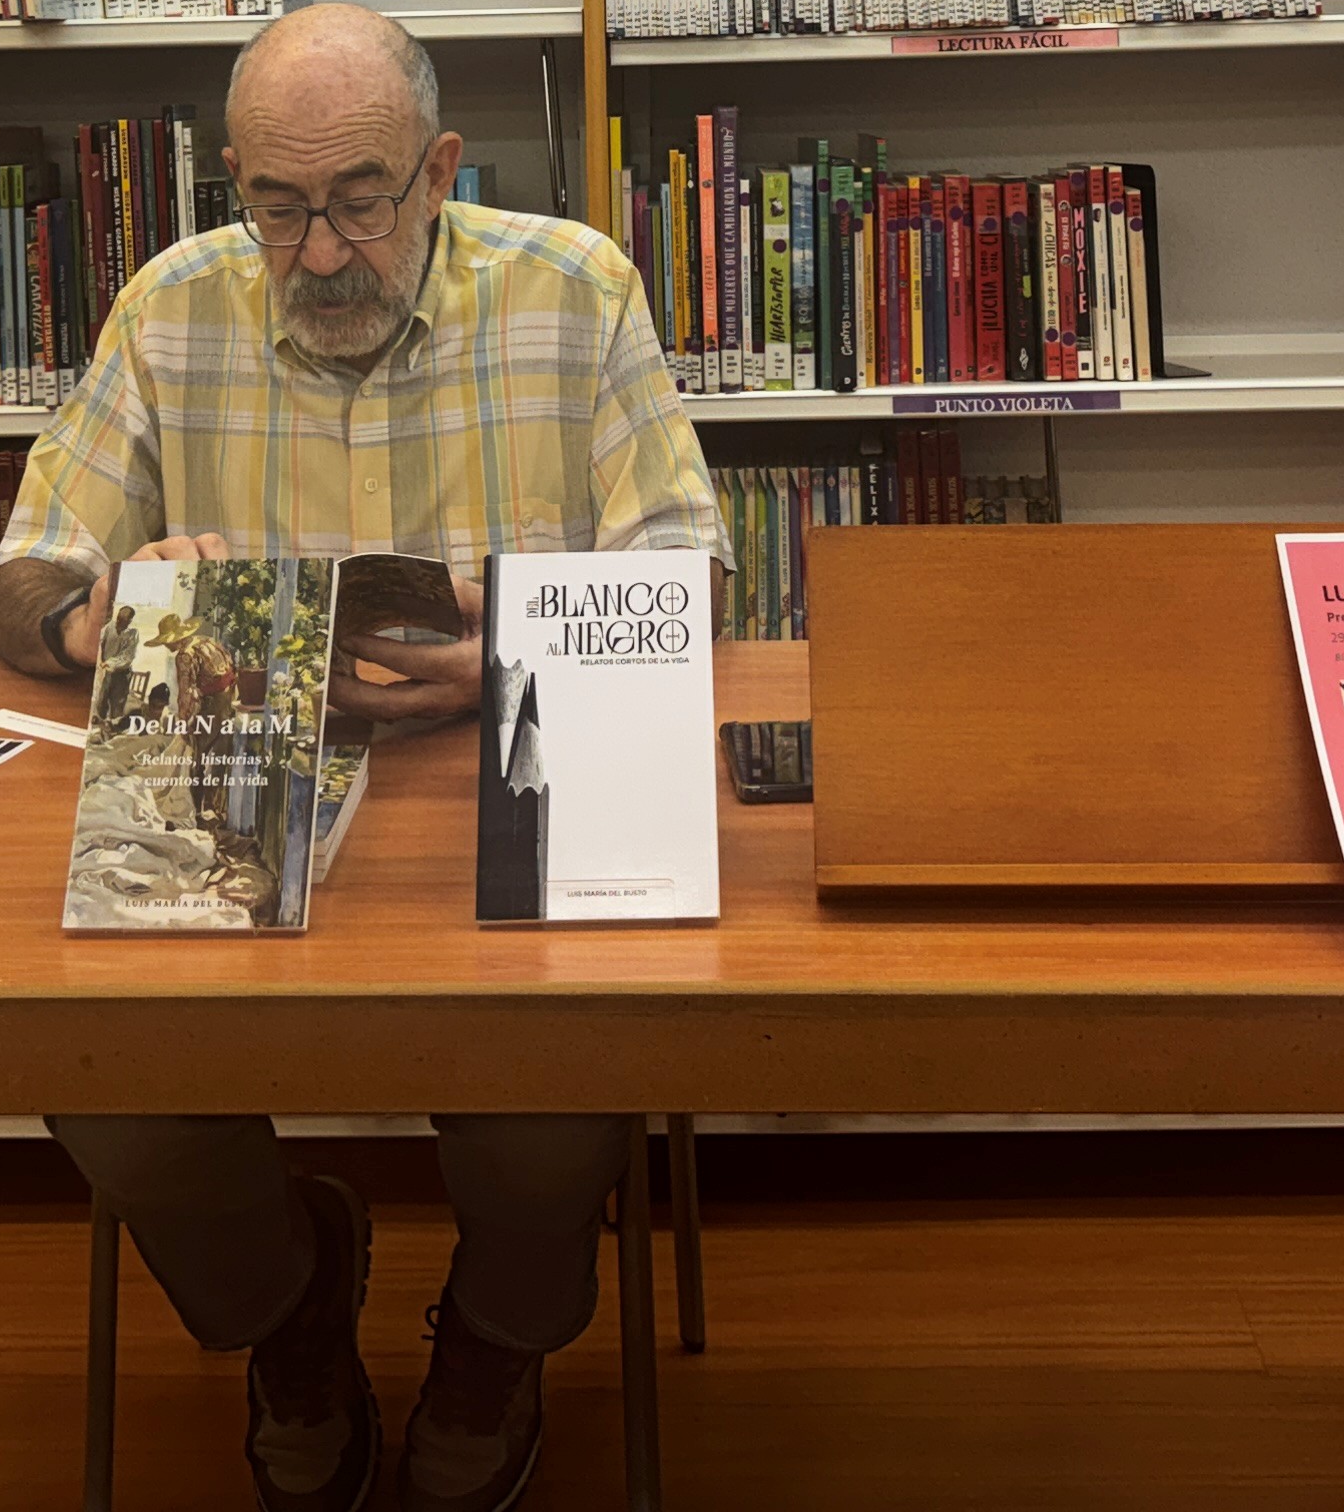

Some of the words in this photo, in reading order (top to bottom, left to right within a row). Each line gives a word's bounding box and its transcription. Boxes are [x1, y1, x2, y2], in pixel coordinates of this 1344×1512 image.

[937, 37, 1016, 52] LECTURA
[1020, 32, 1069, 49] FÁCIL
[723, 171, 735, 183] EL
[723, 187, 736, 243] CAMBIARON
[723, 245, 737, 265] QUE
[1073, 208, 1087, 314] MOXIE
[723, 269, 737, 312] MUJERES
[723, 317, 737, 343] OCHO
[936, 398, 995, 413] PUNTO
[998, 396, 1074, 412] VIOLETA
[526, 597, 540, 618] DEL
[540, 581, 689, 618] BLANCO
[546, 642, 562, 656] AL
[563, 619, 690, 655] NEGRO
[580, 658, 614, 666] RELATOS
[615, 657, 647, 665] CORTOS
[647, 657, 659, 665] DE
[670, 656, 690, 664] VIDA
[127, 714, 159, 736] De
[165, 713, 188, 736] la
[192, 714, 216, 735] N
[219, 719, 234, 736] a
[240, 713, 263, 736] la
[267, 714, 294, 735] M
[141, 753, 197, 768] Relatos,
[200, 752, 261, 766] historias
[263, 754, 274, 769] y
[144, 776, 200, 787] cuentos
[202, 774, 220, 787] de
[223, 774, 236, 787] la
[238, 774, 269, 786] vida
[125, 899, 150, 908] LUIS
[155, 897, 189, 908] MARÍA
[192, 899, 213, 908] DEL
